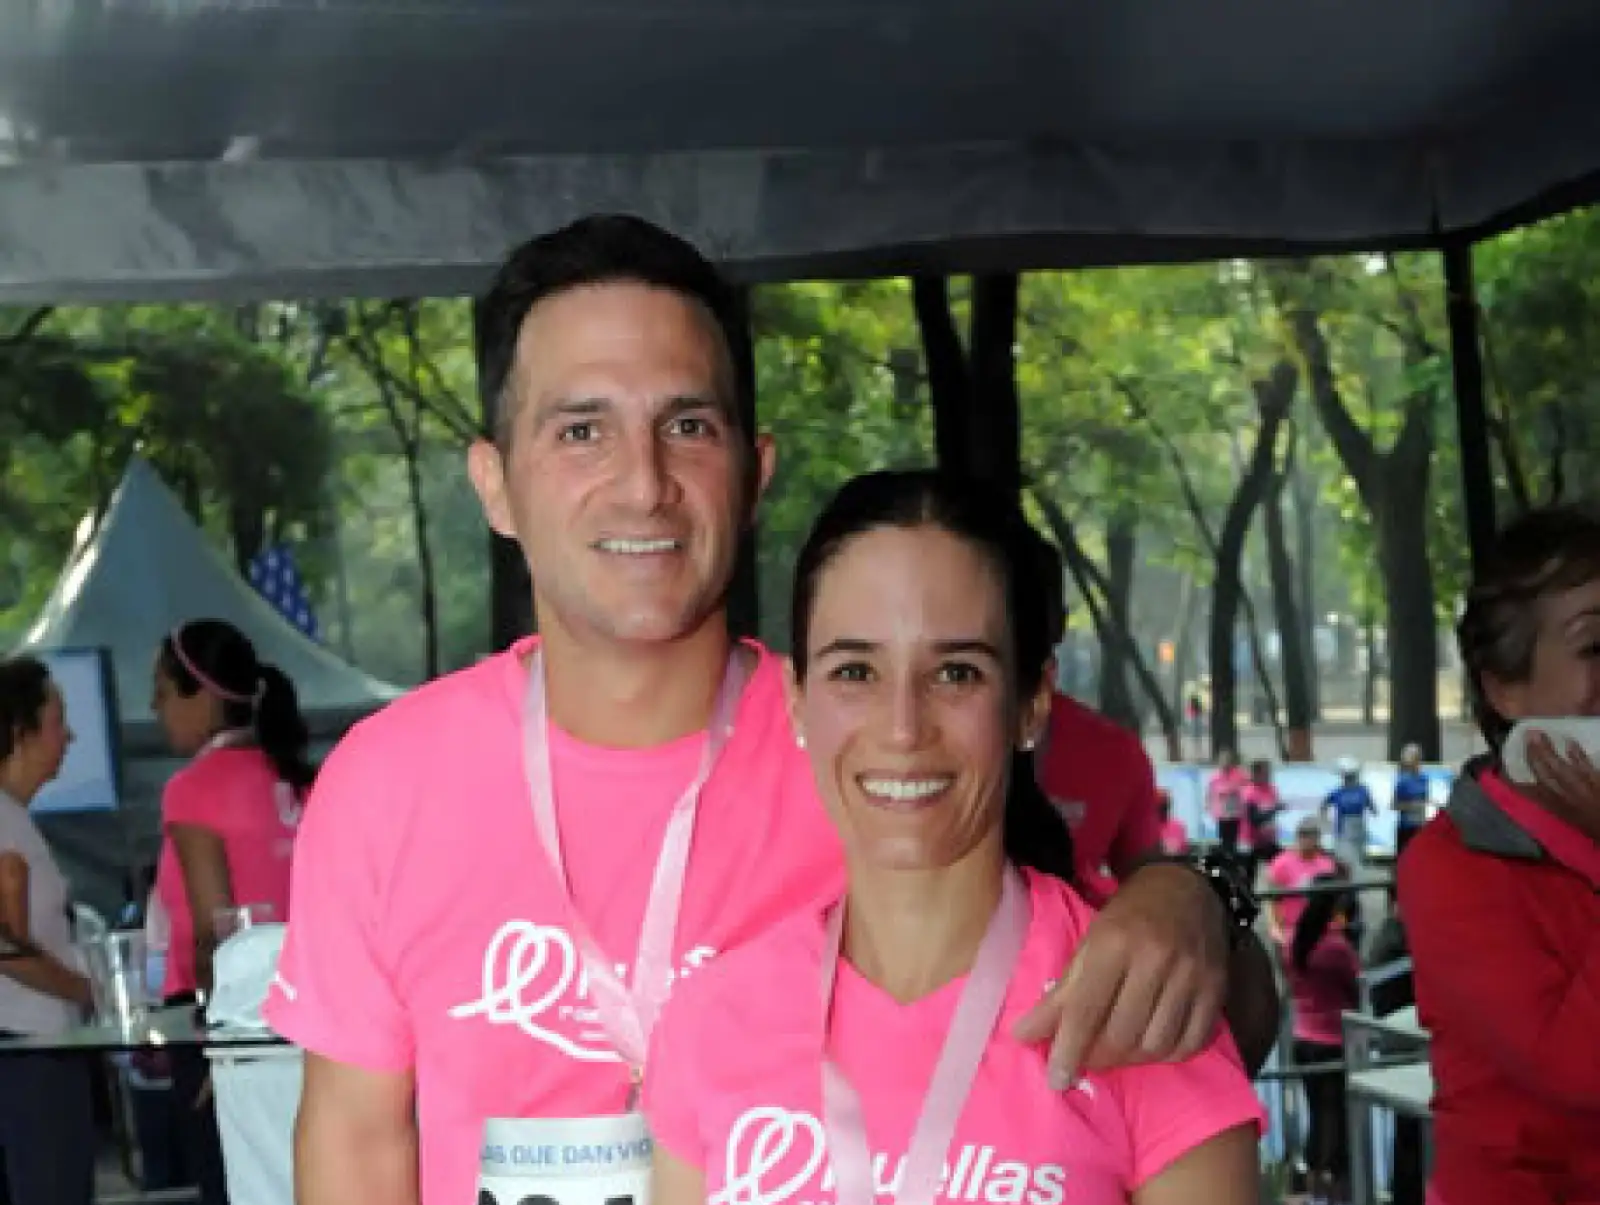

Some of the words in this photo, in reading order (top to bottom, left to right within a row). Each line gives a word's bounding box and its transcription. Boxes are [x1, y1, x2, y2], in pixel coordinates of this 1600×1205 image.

[513, 1143, 554, 1164] QUE
[562, 1143, 613, 1164] DAN
[617, 1137, 653, 1162] VID
